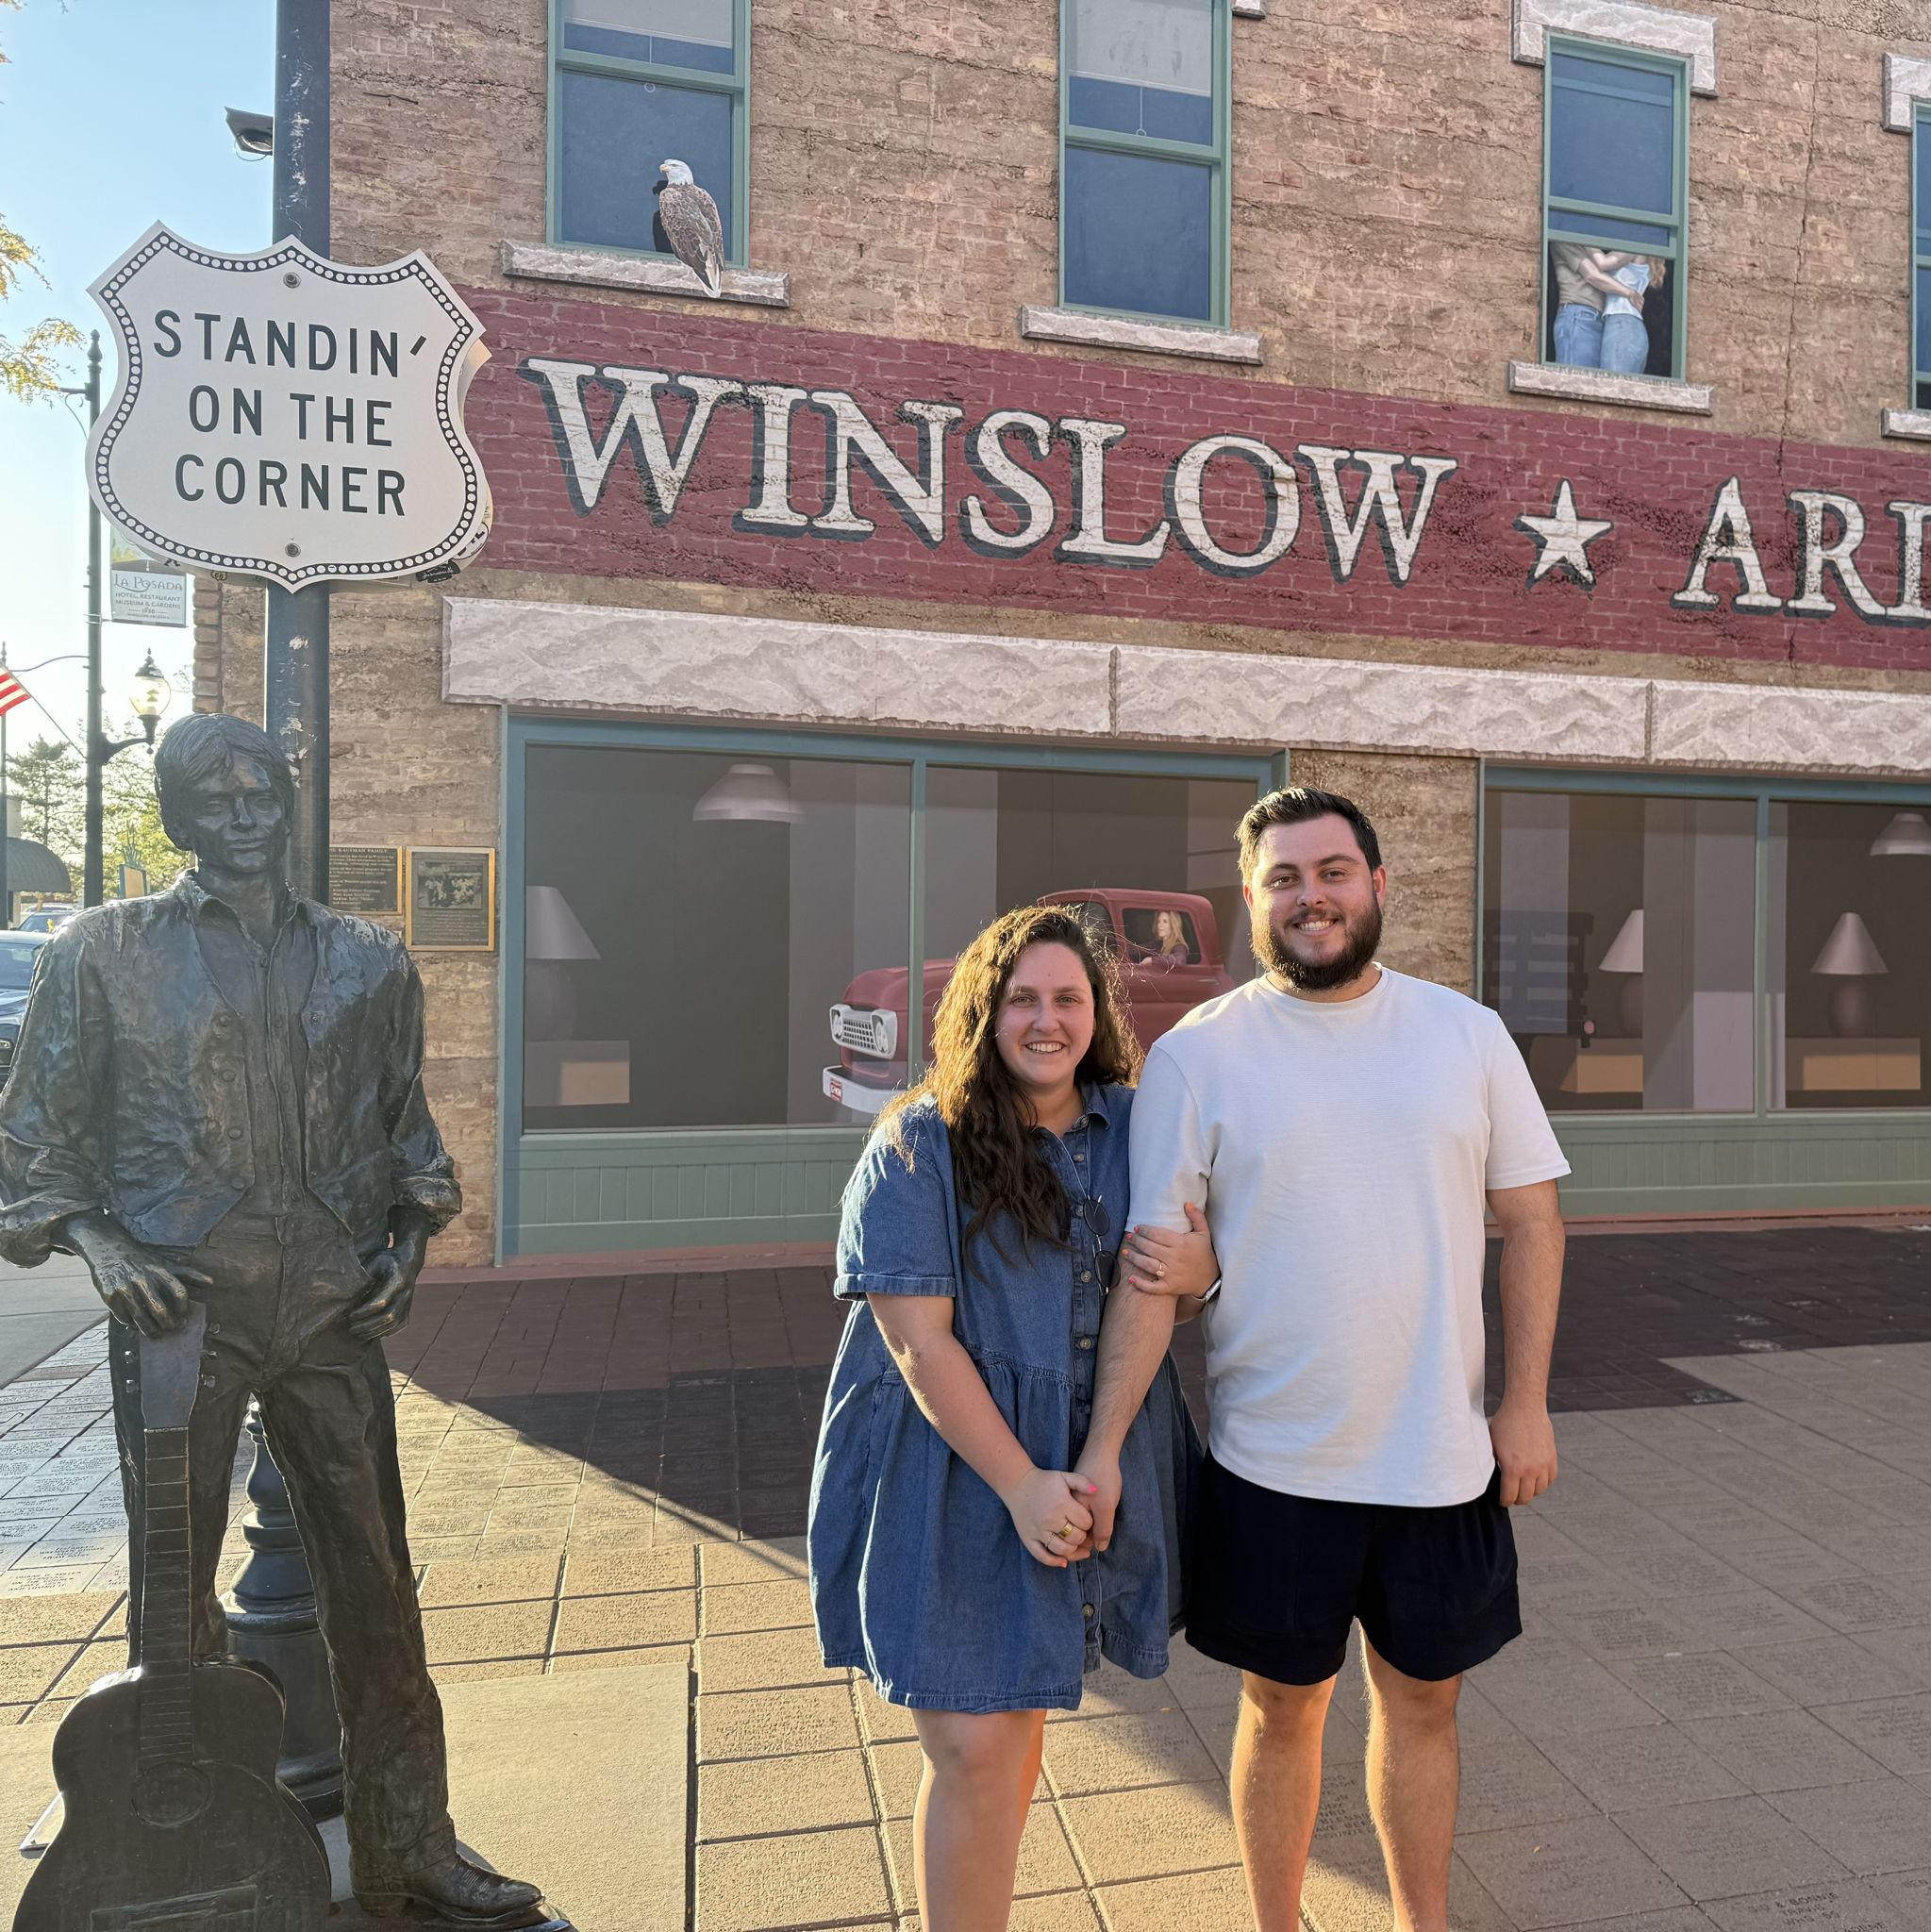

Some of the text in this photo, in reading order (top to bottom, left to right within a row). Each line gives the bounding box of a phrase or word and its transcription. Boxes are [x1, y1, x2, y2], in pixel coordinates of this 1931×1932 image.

[154, 308, 427, 378] STANDIN'
[189, 384, 393, 447] ON THE
[175, 454, 407, 517] CORNER
[519, 358, 1459, 589] WINSLOW
[134, 575, 182, 591] POSADA
[140, 593, 181, 602] RESTAURANT
[151, 601, 181, 609] GARDENS
